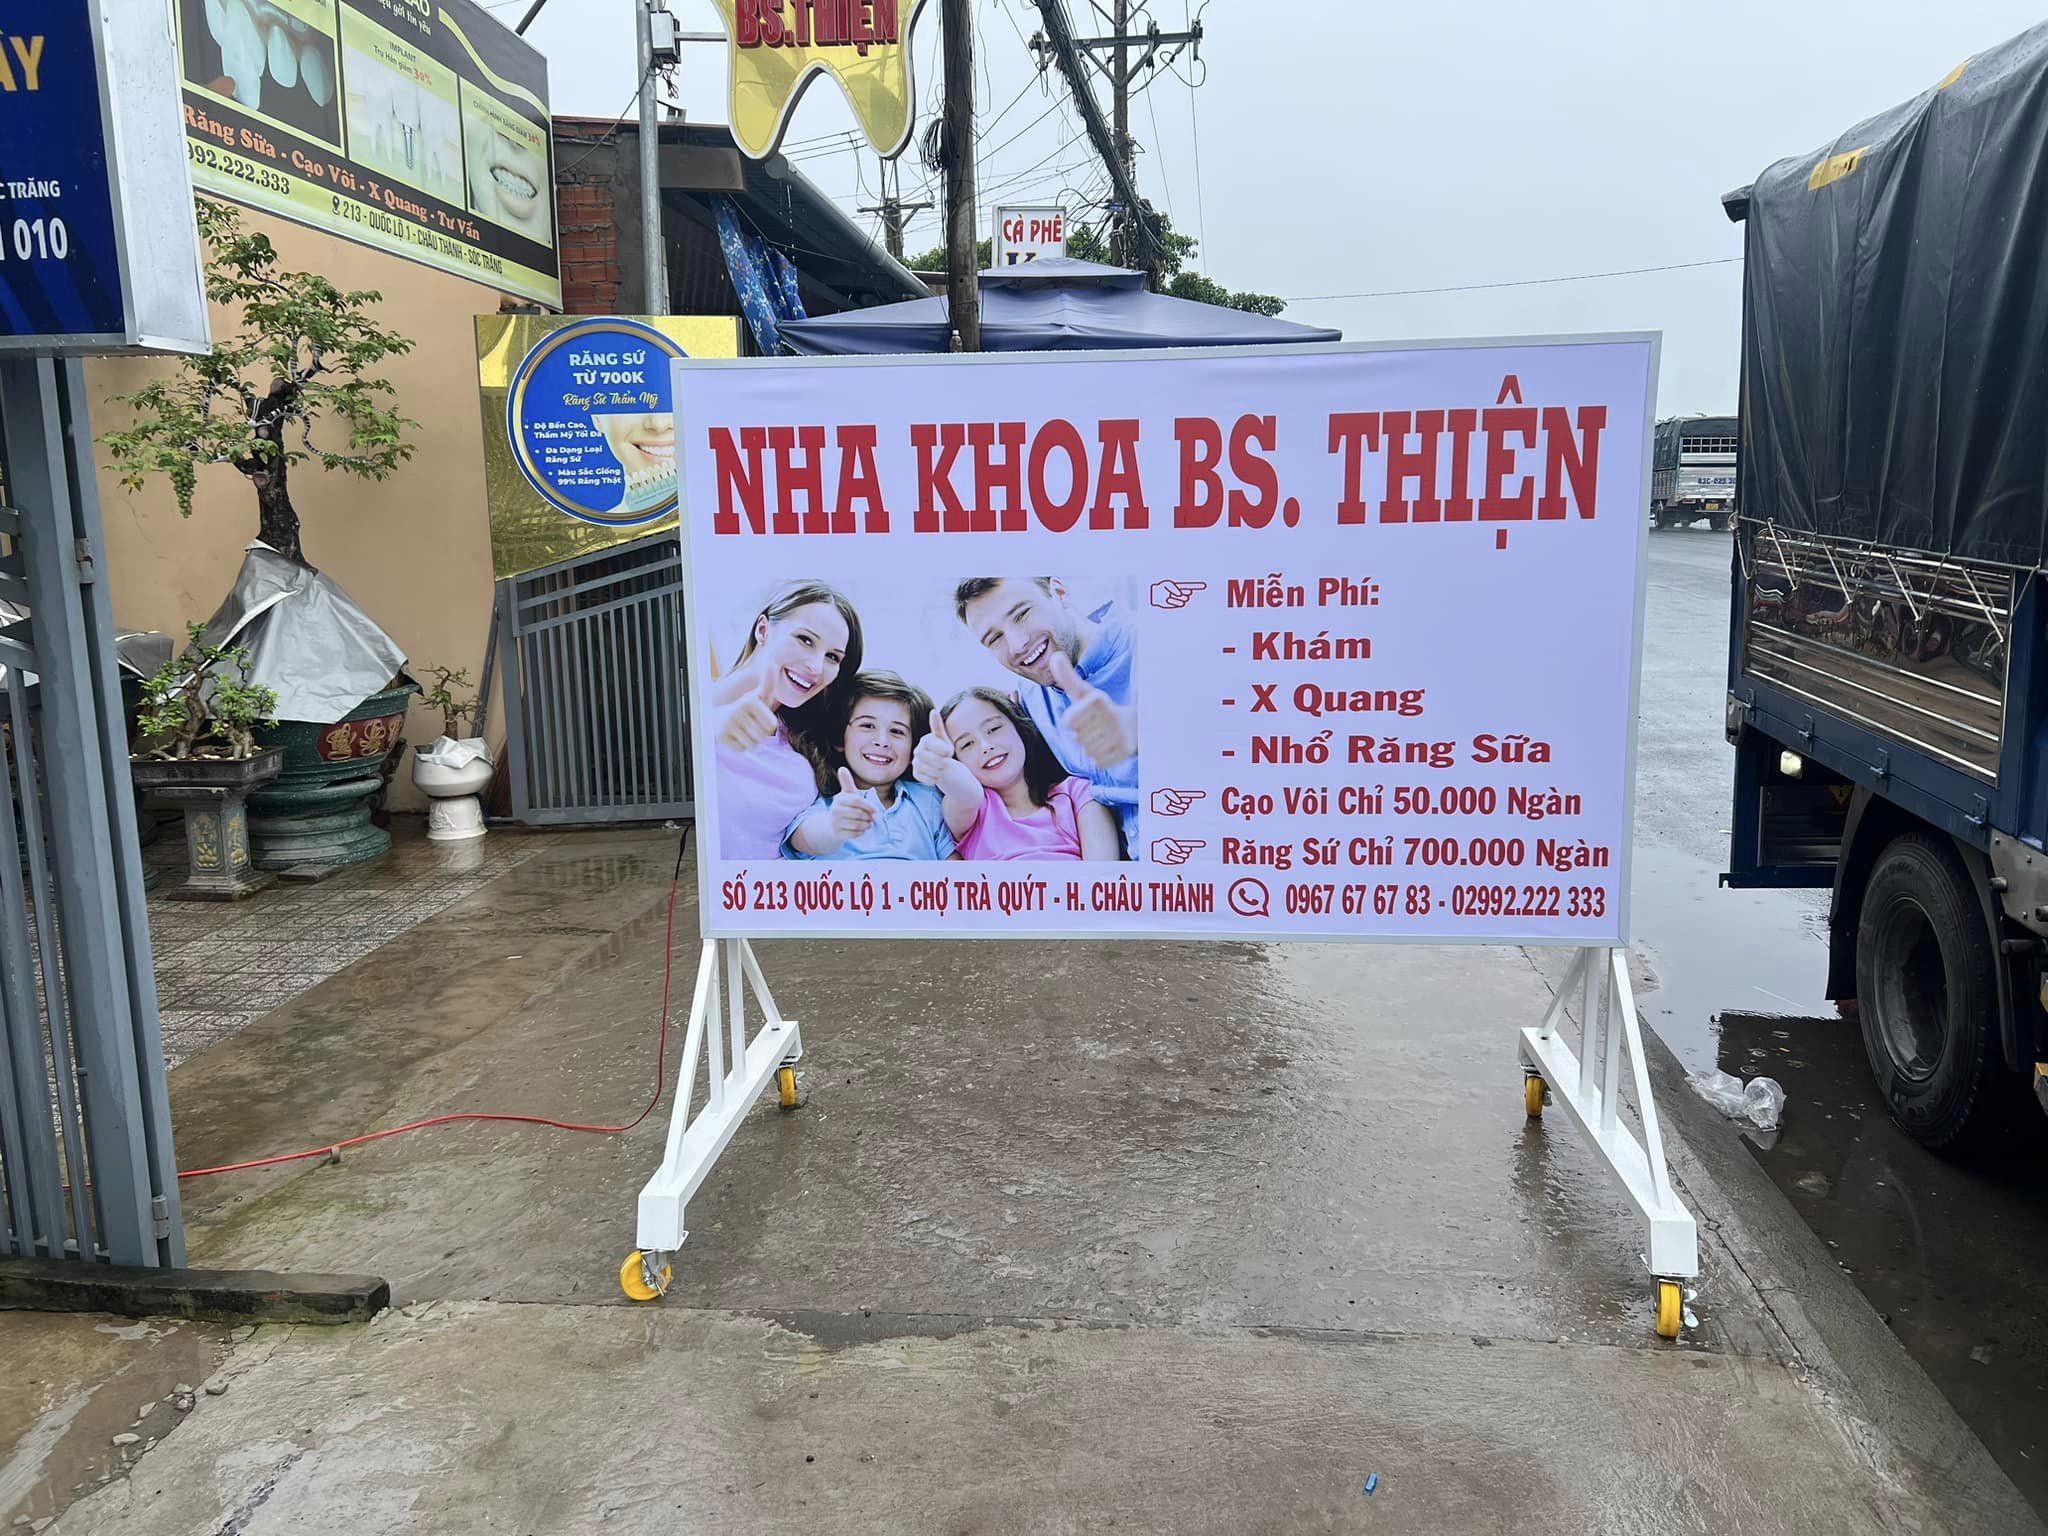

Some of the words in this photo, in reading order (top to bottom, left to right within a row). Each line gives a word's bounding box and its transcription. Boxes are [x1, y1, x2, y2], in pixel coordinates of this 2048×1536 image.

[8, 177, 61, 199] TRĂNG
[183, 104, 236, 147] Răng
[240, 127, 277, 159] Sữa
[291, 150, 325, 178] Cạo
[328, 163, 357, 191] Vôi
[368, 181, 382, 201] X
[384, 188, 429, 223] Quang
[437, 209, 456, 231] Tư
[456, 218, 481, 241] Vấn
[343, 201, 362, 223] 213
[1002, 212, 1025, 245] CÀ
[1030, 213, 1063, 246] PHÊ
[13, 217, 69, 261] 010
[569, 349, 619, 367] RĂNG
[622, 349, 647, 366] SỨ
[573, 369, 597, 385] TỪ
[600, 371, 645, 385] 700K
[708, 424, 890, 535] NHA
[910, 418, 1150, 533] KHOA
[1173, 413, 1301, 530] BS.
[1327, 374, 1608, 550] THIỆN
[1227, 572, 1305, 609] Miễn
[1318, 576, 1380, 607] Phí:
[1252, 630, 1371, 661] Khám
[1249, 684, 1278, 713] X
[1293, 683, 1426, 718] Quang
[1251, 729, 1334, 764] Nhổ
[1347, 735, 1456, 769] Răng
[1471, 733, 1551, 764] Sữa
[1221, 786, 1274, 821] Cạo
[1283, 786, 1328, 816] Vôi
[1337, 784, 1384, 815] Chỉ
[1393, 786, 1497, 815] 50.000
[1507, 786, 1581, 821] Ngàn
[1222, 837, 1293, 871] Răng
[1302, 837, 1341, 866] Sứ
[1348, 835, 1394, 866] Chỉ
[1403, 837, 1525, 867] 700.000
[1535, 838, 1609, 872] Ngàn
[722, 869, 748, 911] SỐ
[753, 880, 788, 910] 213
[793, 869, 844, 916] QUỐC
[849, 872, 874, 917] LỘ
[881, 881, 892, 911] 1
[910, 876, 949, 917] CHỢ
[953, 873, 992, 911] TRÀ
[997, 873, 1048, 917] QUÝT
[1066, 881, 1086, 912] H.
[1091, 873, 1143, 912] CHÂU
[1148, 874, 1214, 913] THÀNH
[1285, 883, 1336, 915] 0967
[1341, 884, 1367, 915] 67
[1373, 884, 1399, 915] 67
[1405, 884, 1431, 916] 83
[1451, 884, 1561, 917] 02992.222
[1566, 885, 1606, 918] 333
